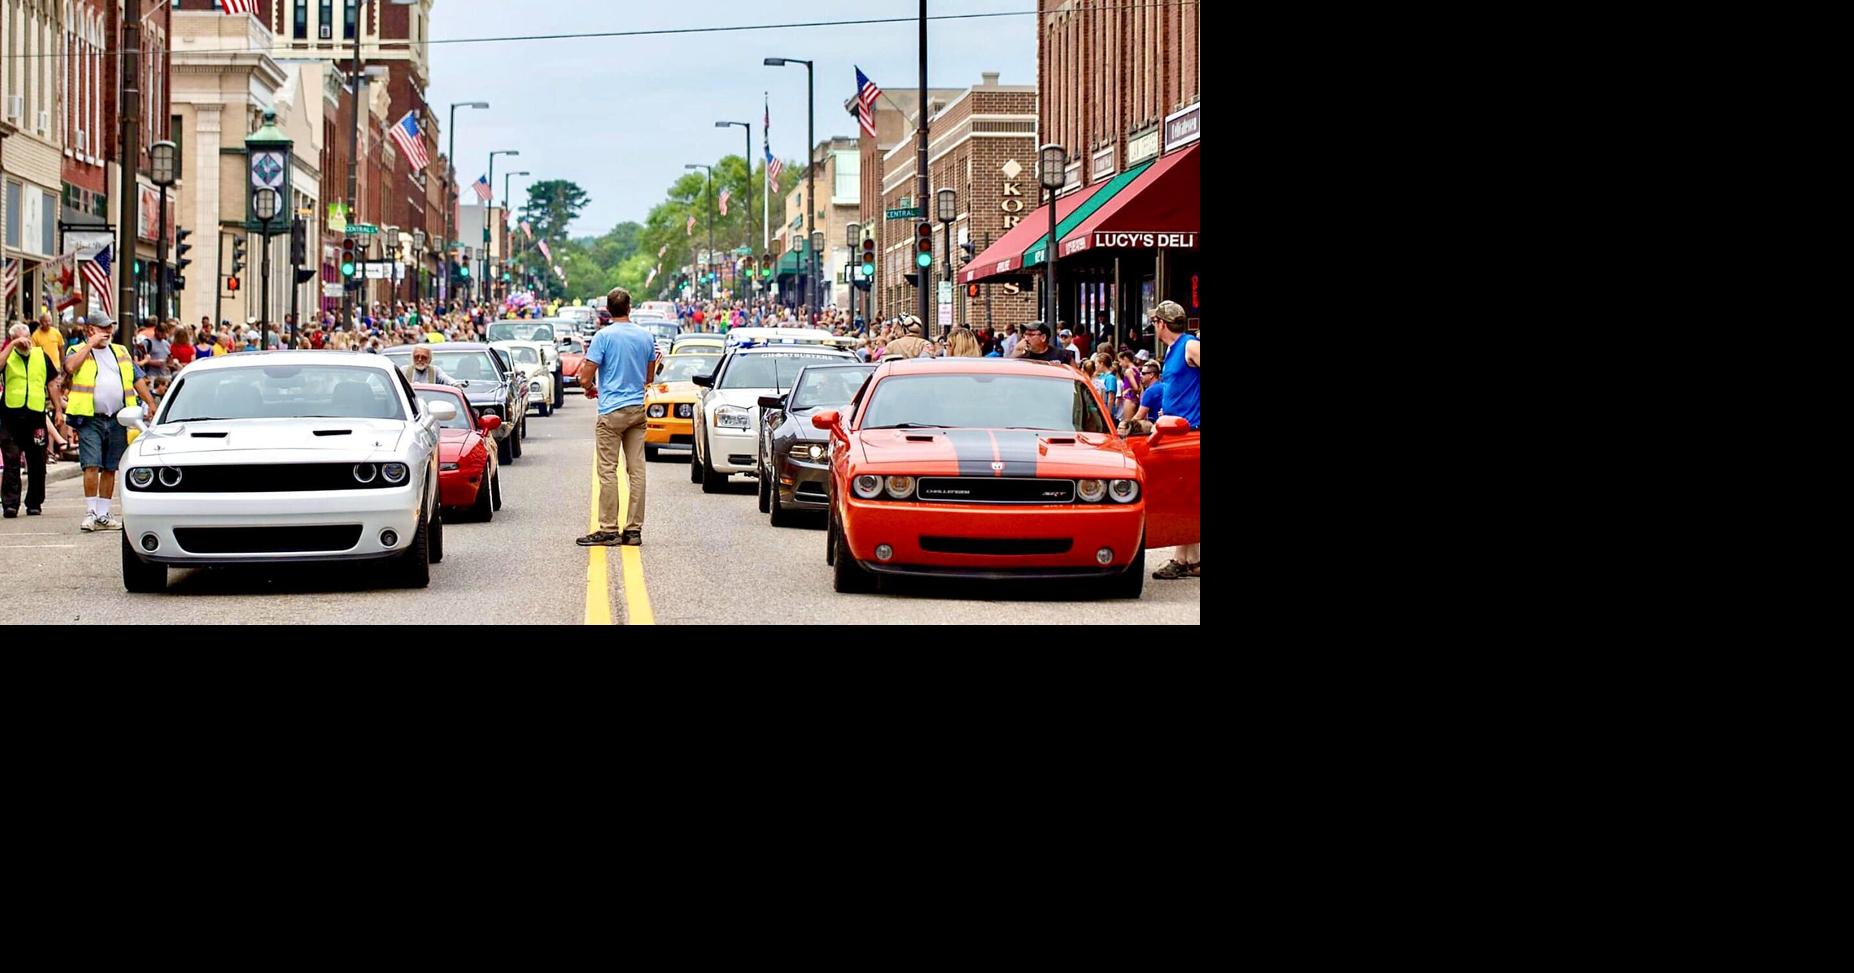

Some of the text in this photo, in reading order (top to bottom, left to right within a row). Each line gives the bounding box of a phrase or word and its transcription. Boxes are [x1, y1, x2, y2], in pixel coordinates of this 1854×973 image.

[886, 210, 916, 218] CENTRAL
[1095, 233, 1154, 247] LUCY'S
[1157, 233, 1193, 248] DELI
